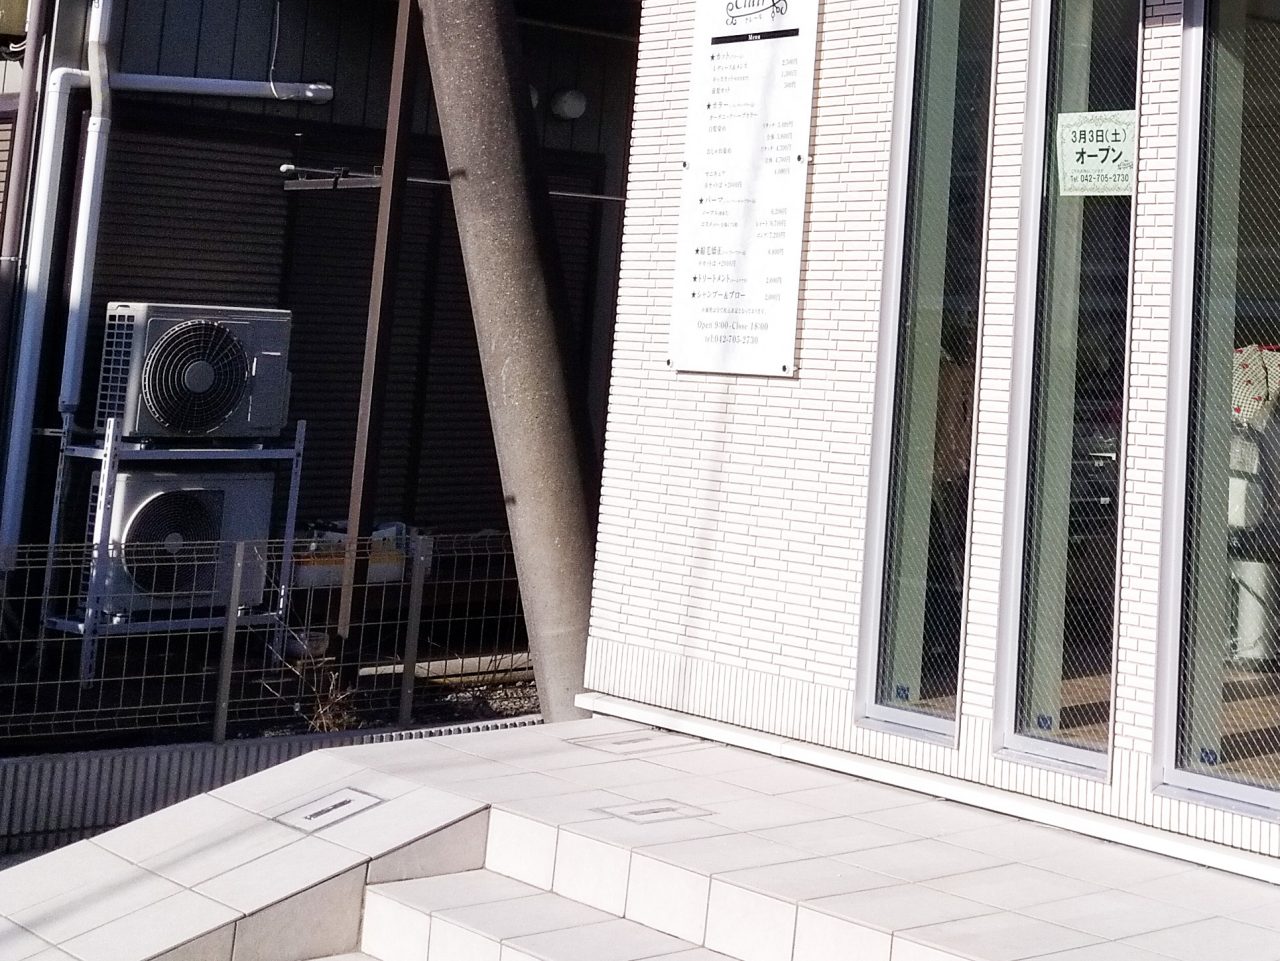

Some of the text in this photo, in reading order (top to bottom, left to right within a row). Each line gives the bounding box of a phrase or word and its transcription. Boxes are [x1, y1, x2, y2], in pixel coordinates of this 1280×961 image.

[1075, 145, 1123, 165] オープン
[1080, 173, 1129, 182] 042-705-2730
